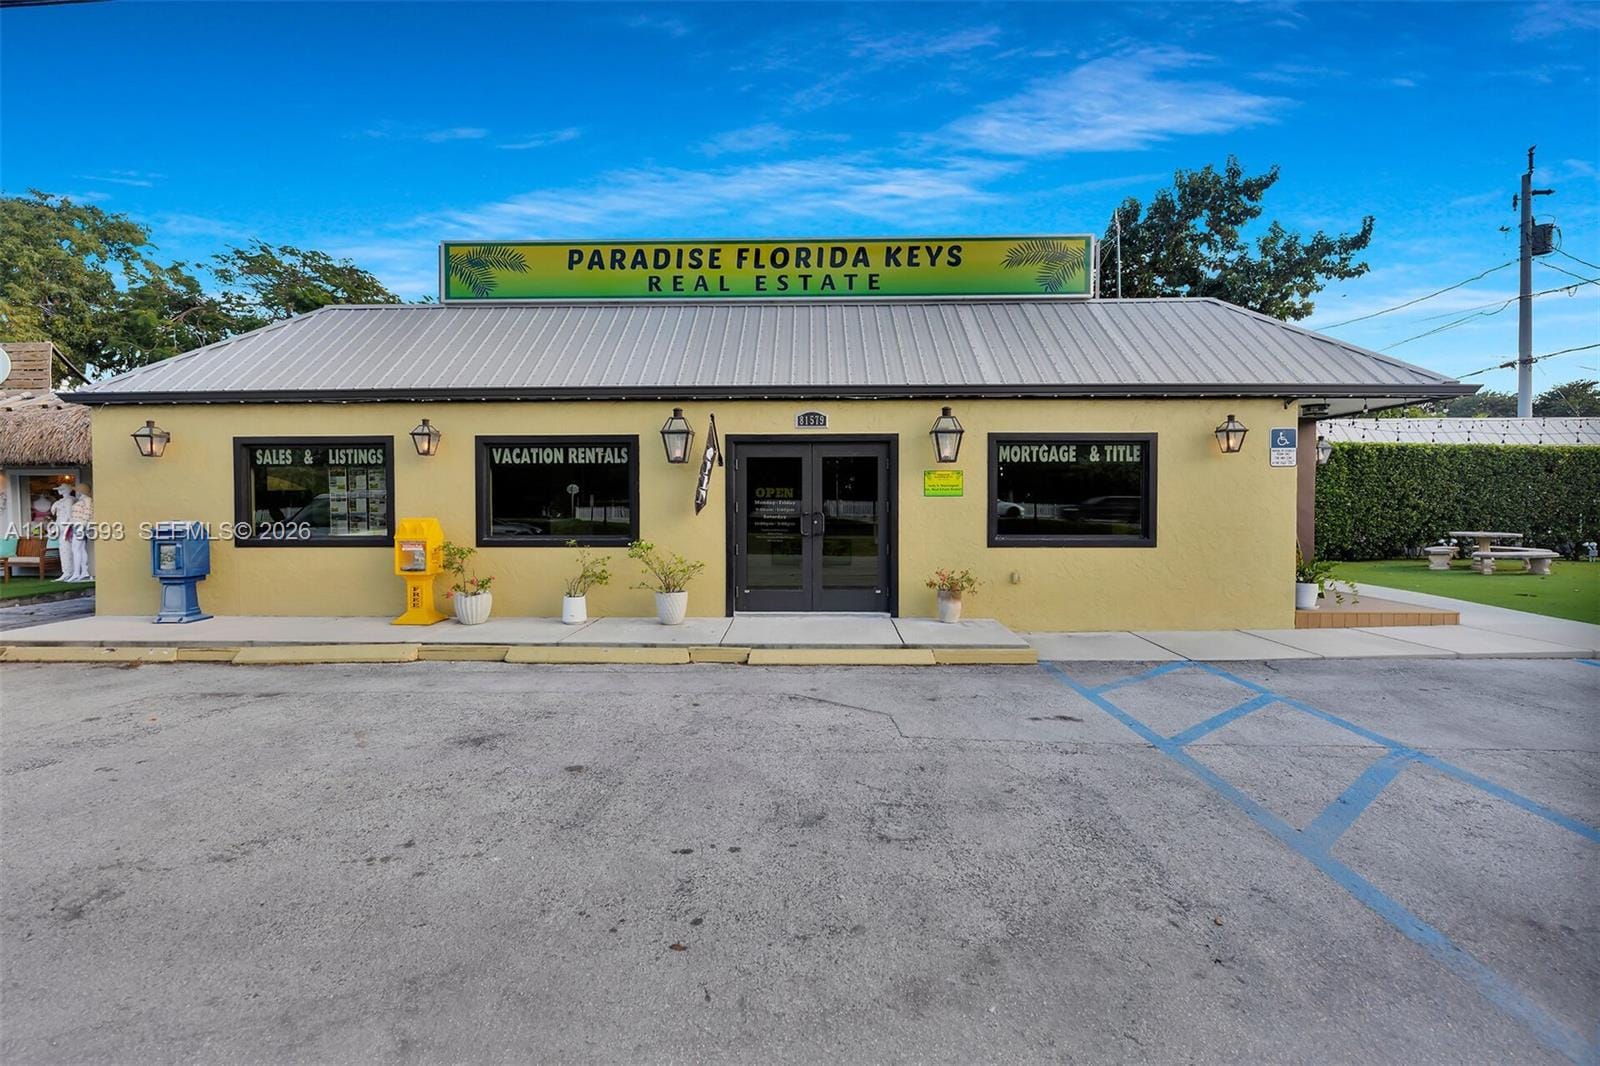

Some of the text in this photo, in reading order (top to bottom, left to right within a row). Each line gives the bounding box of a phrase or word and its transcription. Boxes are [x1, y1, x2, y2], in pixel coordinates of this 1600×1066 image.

[567, 245, 962, 270] PARADISE FLORIDA KEYS
[648, 273, 880, 292] REAL ESTATE
[799, 415, 825, 425] 81579
[255, 448, 384, 465] SALES & LISTINGS
[492, 447, 629, 464] VACATION RENTALS
[998, 444, 1141, 463] MORTGAGE & TITLE
[755, 487, 794, 498] OPEN
